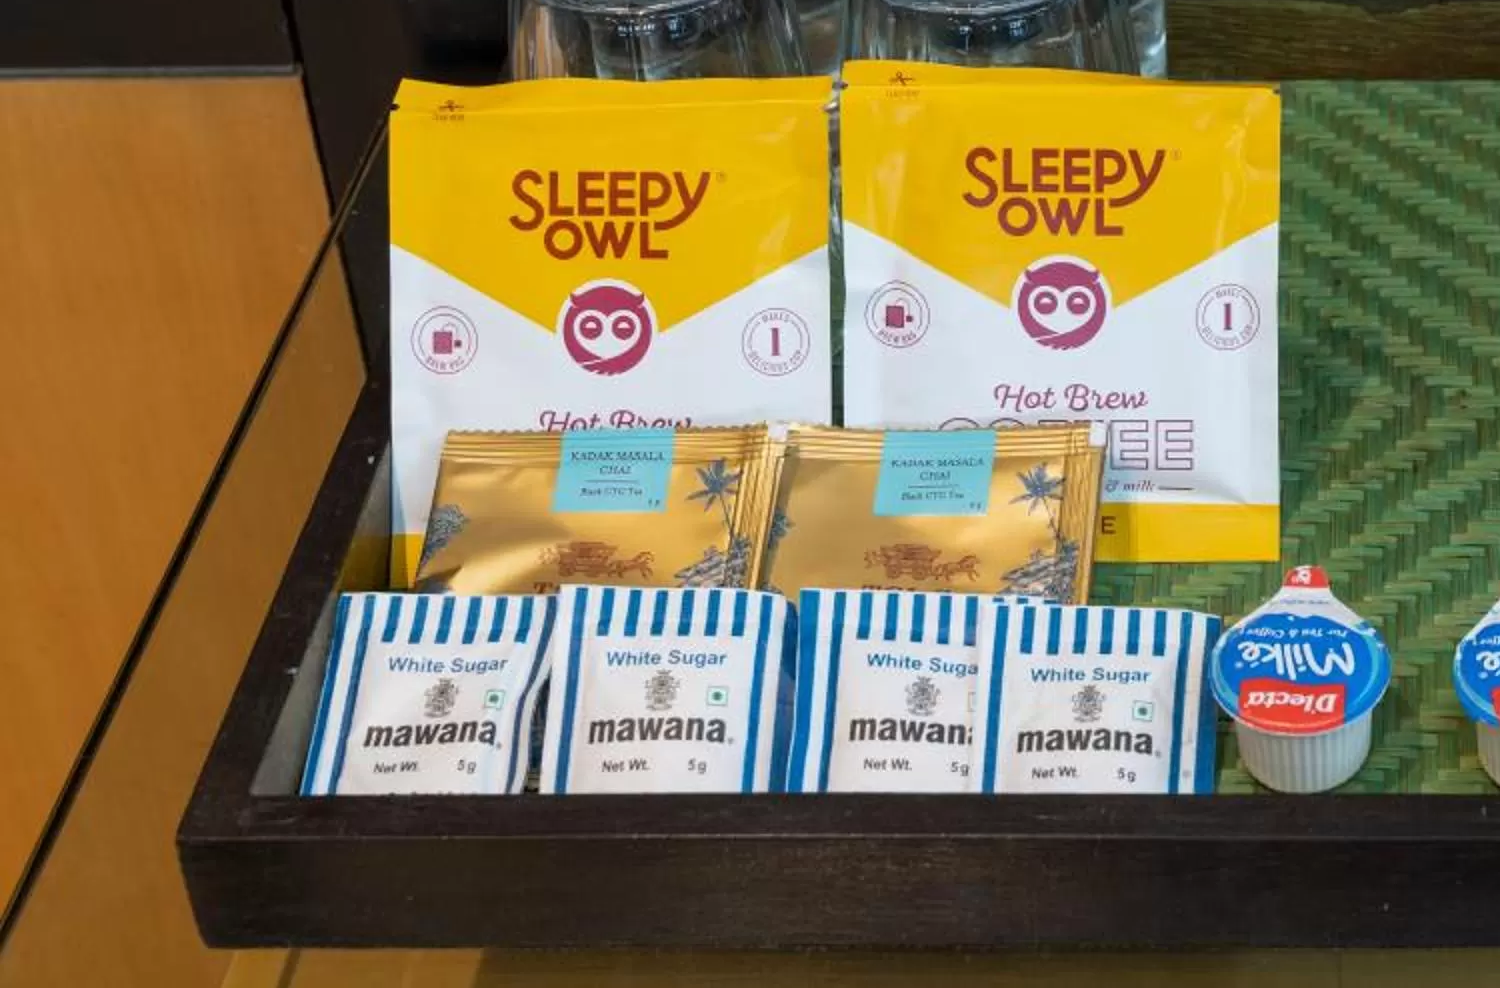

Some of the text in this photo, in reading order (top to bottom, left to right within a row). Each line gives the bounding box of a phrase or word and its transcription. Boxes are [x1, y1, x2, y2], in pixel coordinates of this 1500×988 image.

[962, 146, 1166, 208] SLEEPY
[509, 169, 711, 231] SLEEPY
[997, 197, 1123, 237] OWL
[543, 219, 669, 260] OWL
[994, 383, 1148, 412] Hot Brew
[1123, 479, 1156, 492] milk
[388, 656, 508, 674] White Sugar
[607, 650, 728, 668] White Sugar
[867, 653, 979, 677] White Suga
[1031, 667, 1151, 684] White Sugar
[363, 719, 497, 747] mawana
[588, 716, 727, 745] mawana
[848, 717, 973, 745] mawan
[1016, 727, 1154, 755] mawana
[373, 761, 398, 773] Net
[601, 759, 625, 772] Net
[863, 758, 888, 771] Net
[1031, 767, 1055, 779] Net
